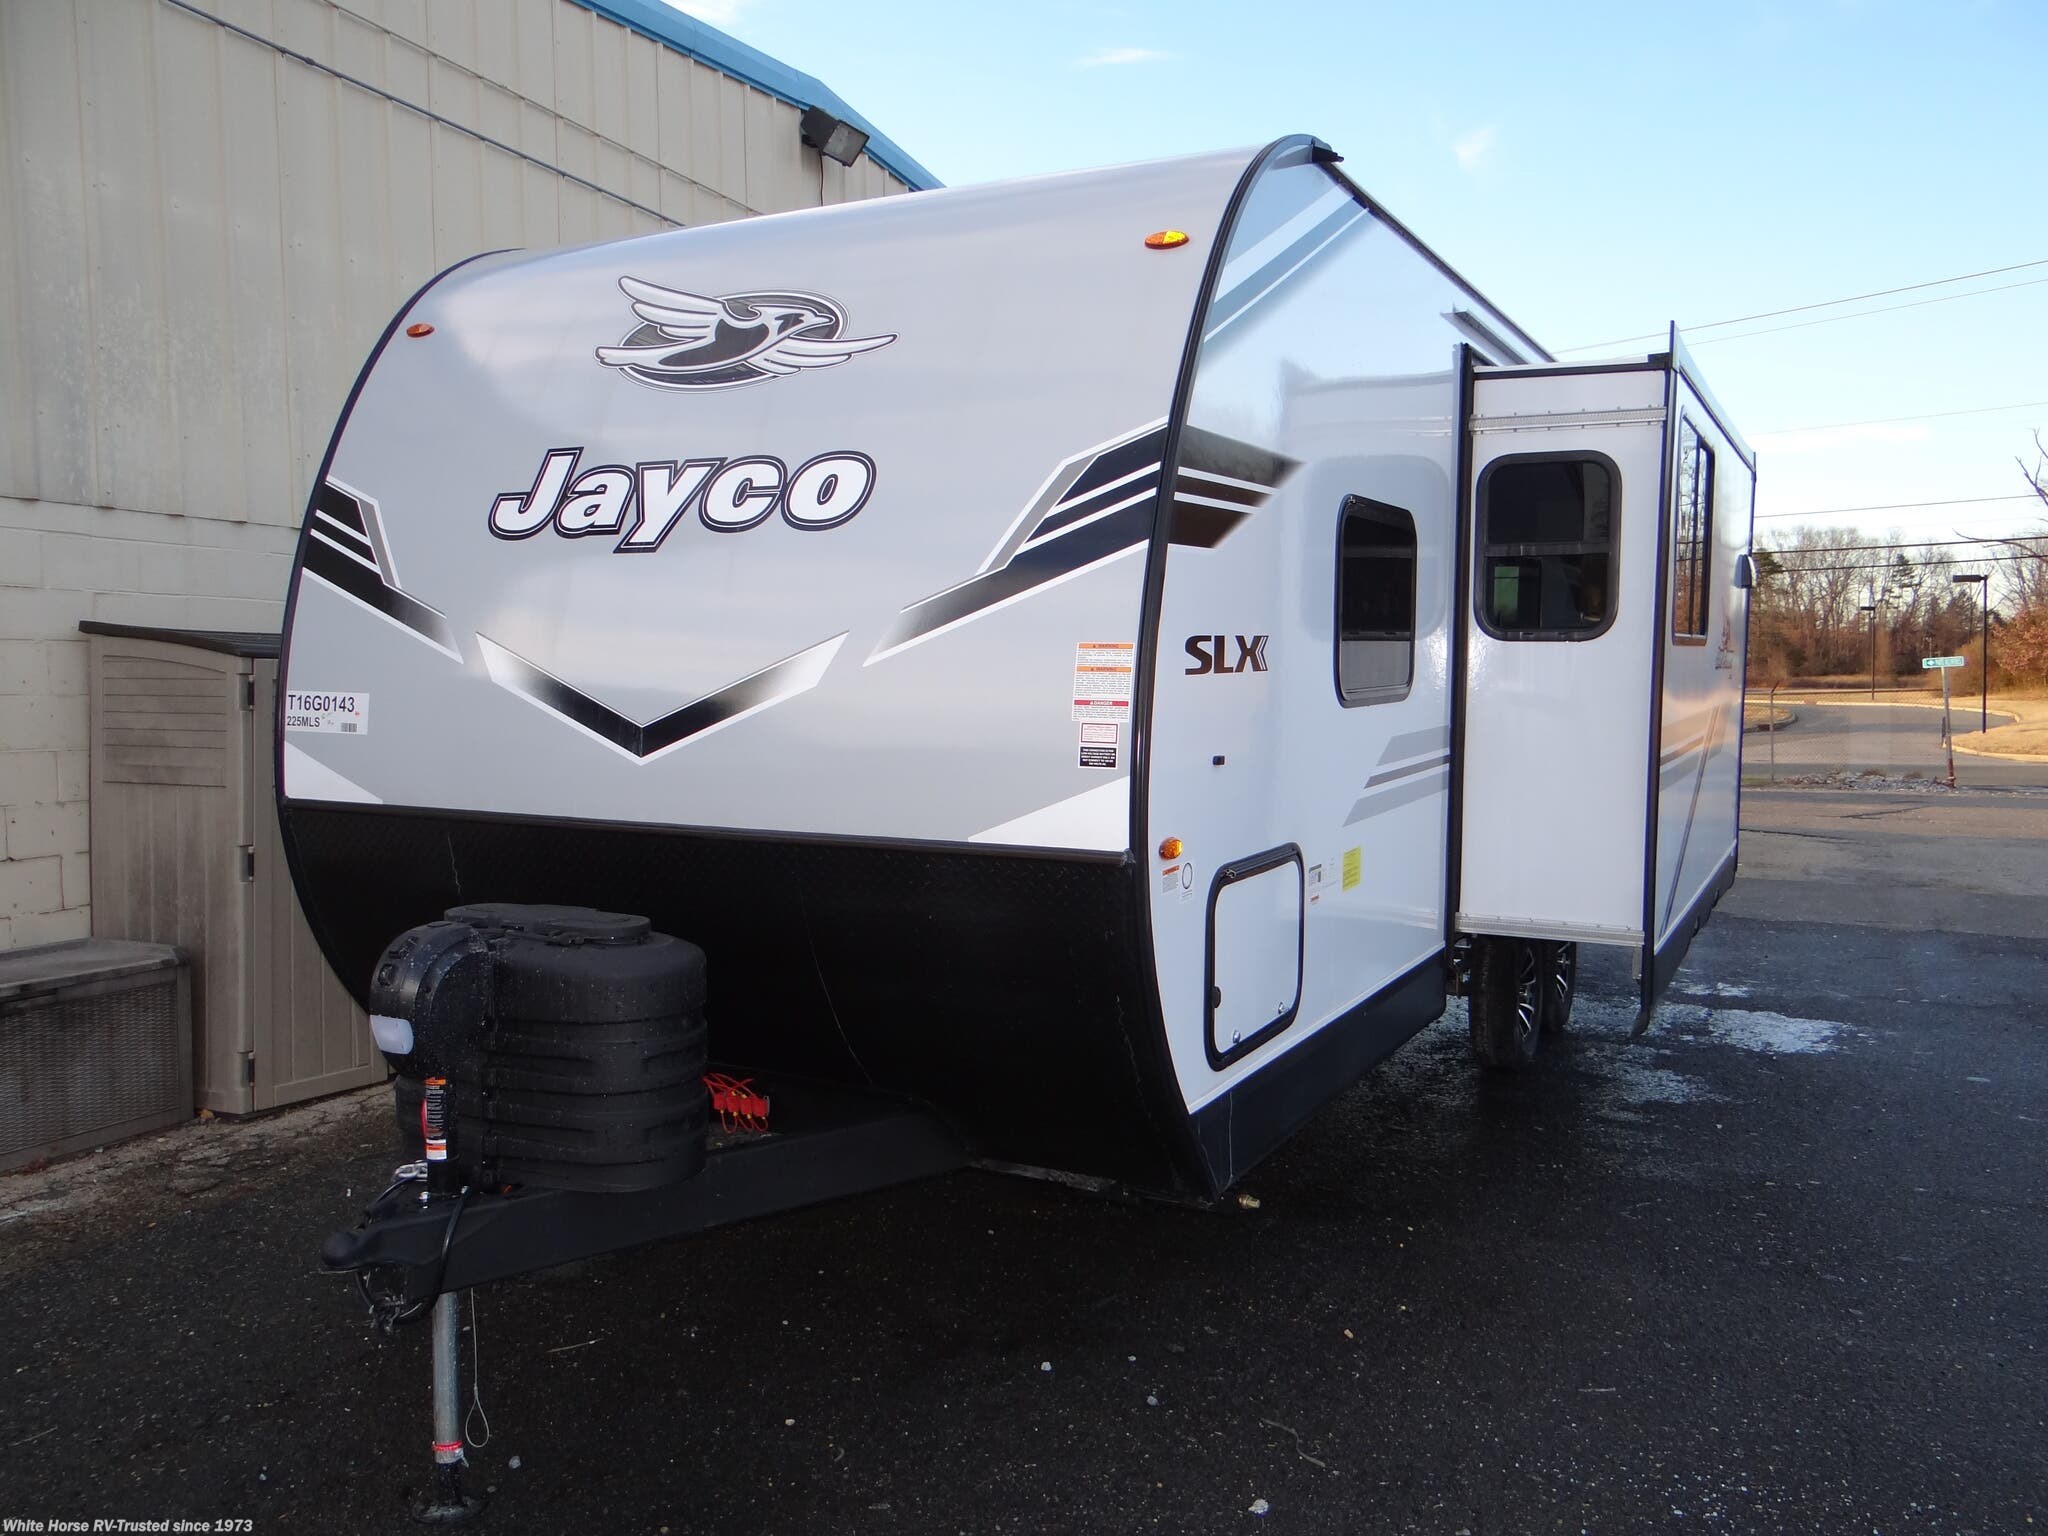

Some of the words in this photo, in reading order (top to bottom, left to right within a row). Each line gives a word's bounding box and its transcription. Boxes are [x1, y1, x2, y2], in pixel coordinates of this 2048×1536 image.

[487, 447, 877, 553] Jayco
[1185, 635, 1269, 675] SLX
[288, 694, 355, 713] T16G0143
[287, 715, 320, 728] 225MLS
